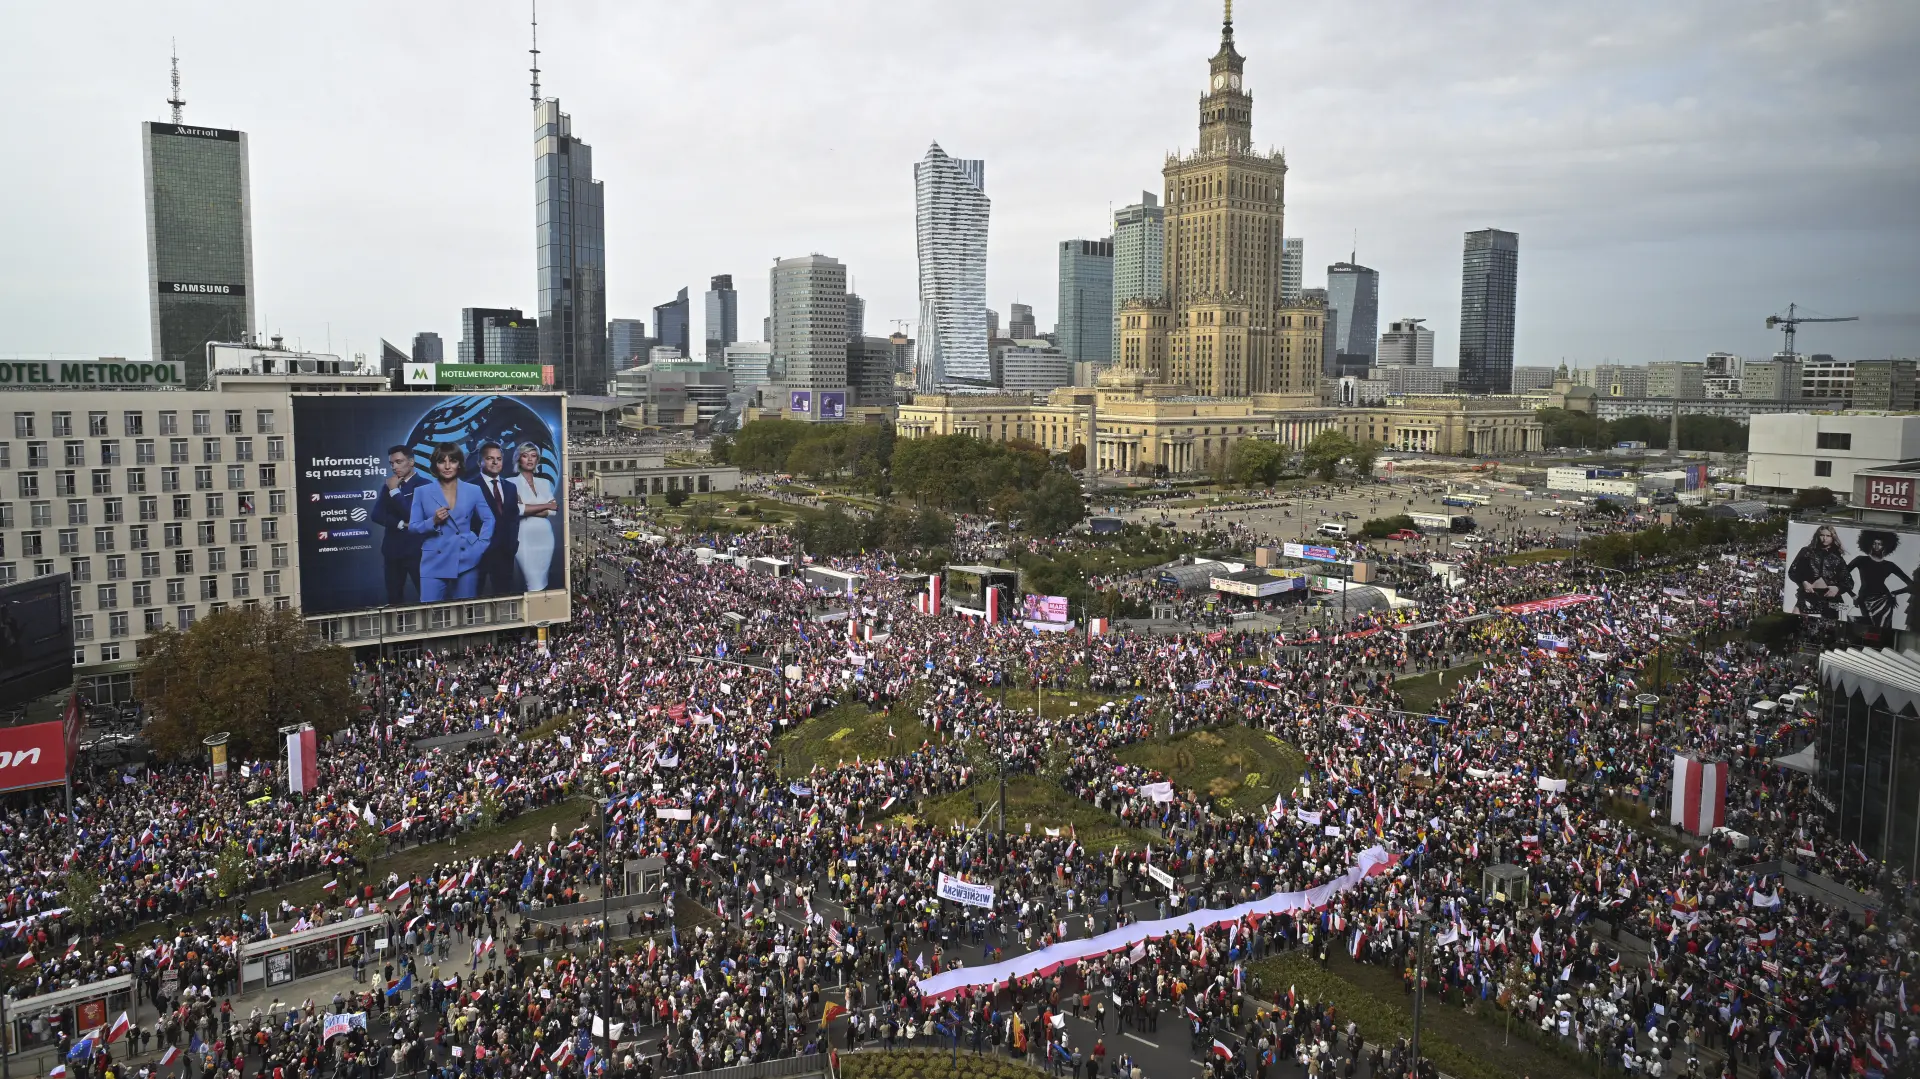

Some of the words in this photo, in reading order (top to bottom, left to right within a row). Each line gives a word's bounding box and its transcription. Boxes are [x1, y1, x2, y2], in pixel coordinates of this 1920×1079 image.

[175, 126, 218, 138] Marriott
[173, 283, 230, 294] SAMSUNG
[60, 363, 182, 384] METROPOL
[441, 370, 540, 379] HOTELMETROPOL.COM.PL
[312, 455, 380, 467] Informacje
[305, 470, 321, 479] są
[323, 468, 361, 478] naszą
[364, 466, 387, 477] siłą
[1871, 480, 1909, 495] Half
[365, 491, 375, 499] 24
[1871, 493, 1908, 506] Price
[320, 508, 347, 517] polsat
[326, 515, 348, 523] news
[332, 530, 369, 538] WYDARZENIA
